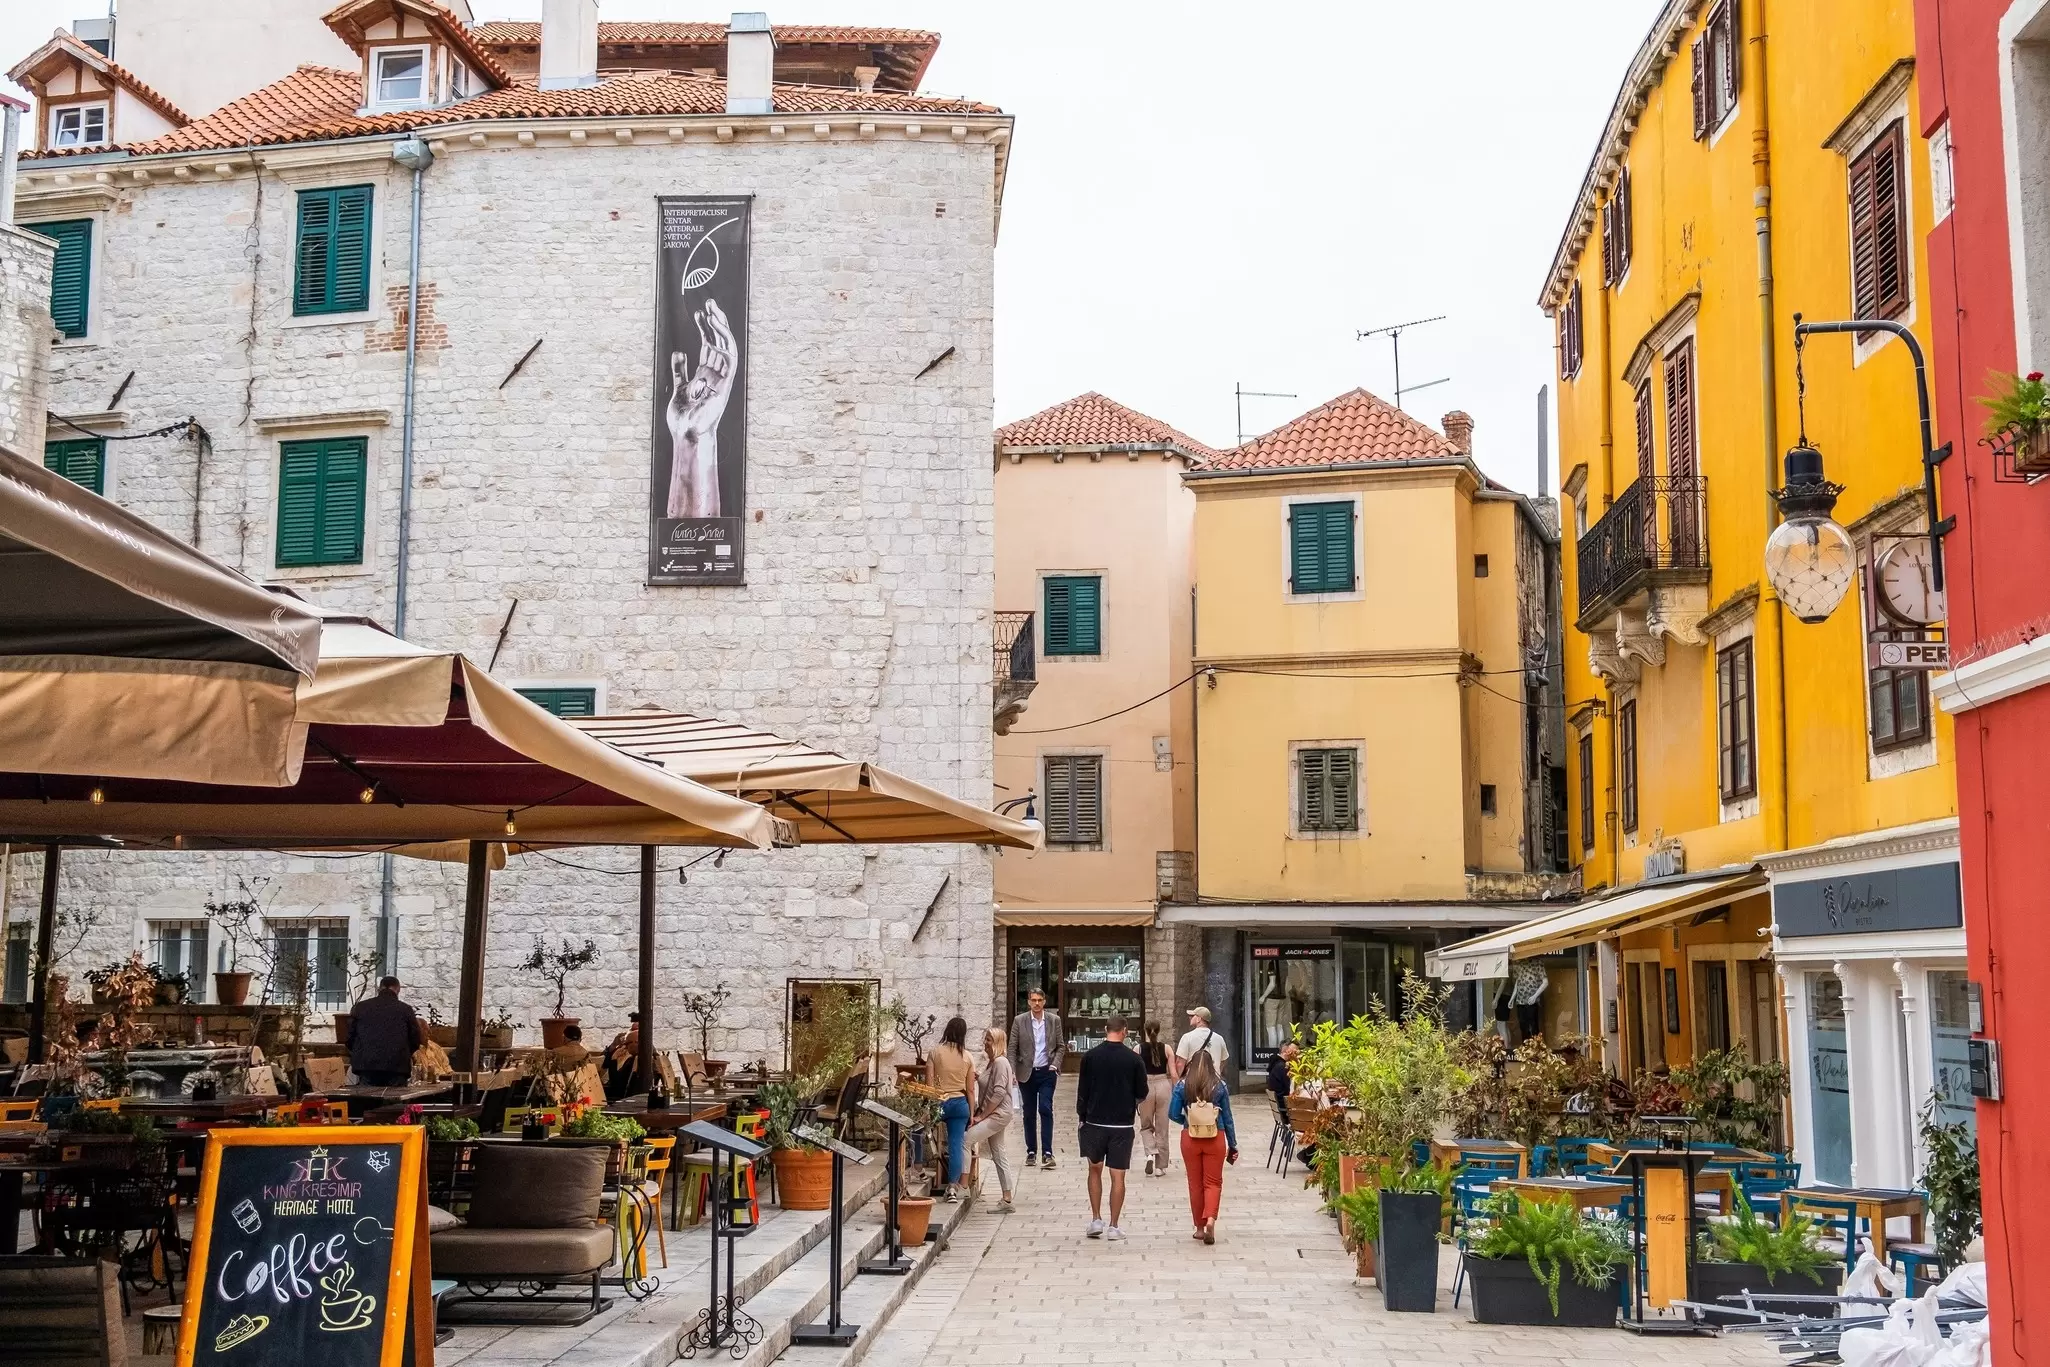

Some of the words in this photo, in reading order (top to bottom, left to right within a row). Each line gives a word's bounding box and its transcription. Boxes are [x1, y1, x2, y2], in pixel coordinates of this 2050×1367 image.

[664, 209, 728, 217] INTERPRETACIJSKI
[663, 233, 691, 241] SVETOG
[663, 241, 690, 249] JAKOVA
[263, 1183, 297, 1200] KING
[301, 1182, 362, 1199] KRESIMIR
[273, 1199, 319, 1216] HERITAGE
[326, 1199, 356, 1215] HOTEL
[217, 1232, 348, 1304] Coffee
